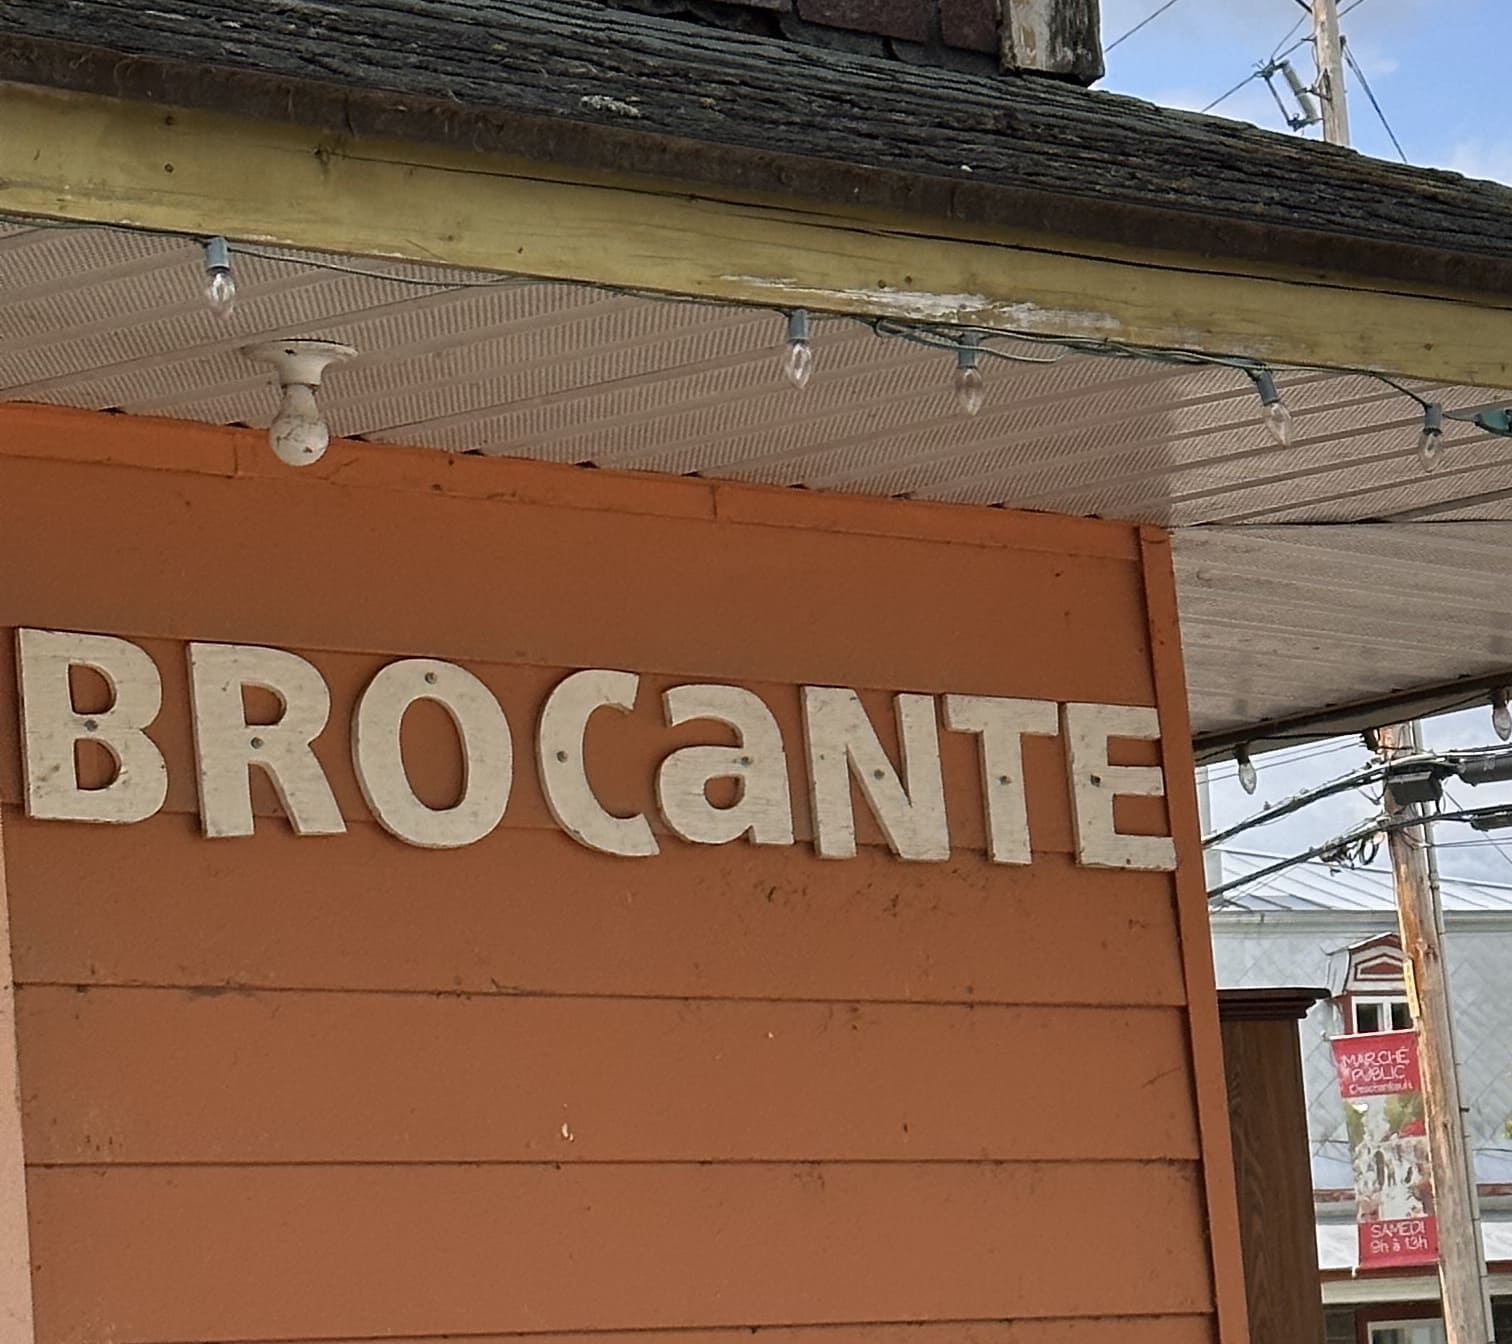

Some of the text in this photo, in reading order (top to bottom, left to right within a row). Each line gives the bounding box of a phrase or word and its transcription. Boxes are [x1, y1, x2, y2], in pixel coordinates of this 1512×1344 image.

[1341, 1045, 1410, 1068] MARCHÉ
[1351, 1064, 1406, 1082] PUBLIC
[1370, 1220, 1425, 1238] SAMEDI
